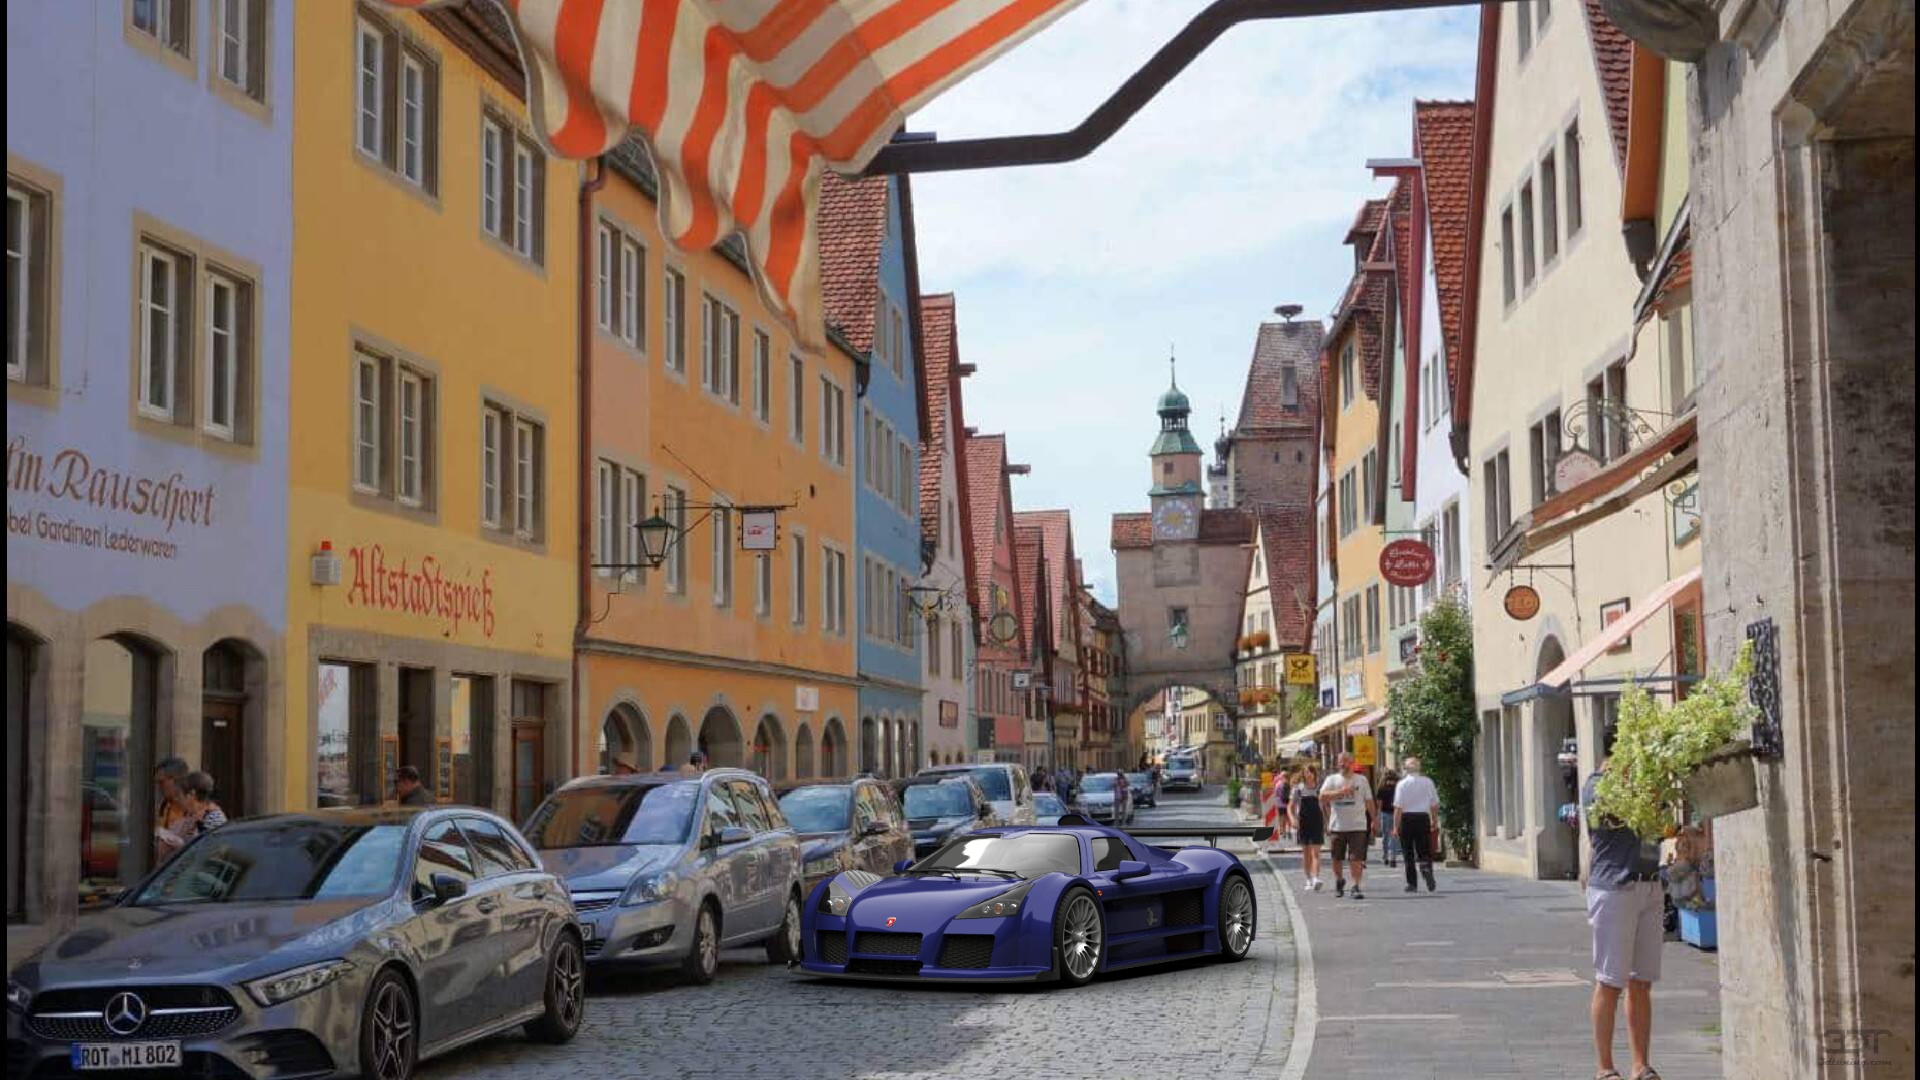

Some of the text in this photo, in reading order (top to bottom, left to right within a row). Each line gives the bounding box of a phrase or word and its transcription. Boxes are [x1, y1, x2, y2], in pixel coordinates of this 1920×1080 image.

[48, 449, 216, 532] Rauschert
[7, 505, 179, 559] bel Gardinen Lederwaren
[81, 1045, 176, 1066] ROT MI 802
